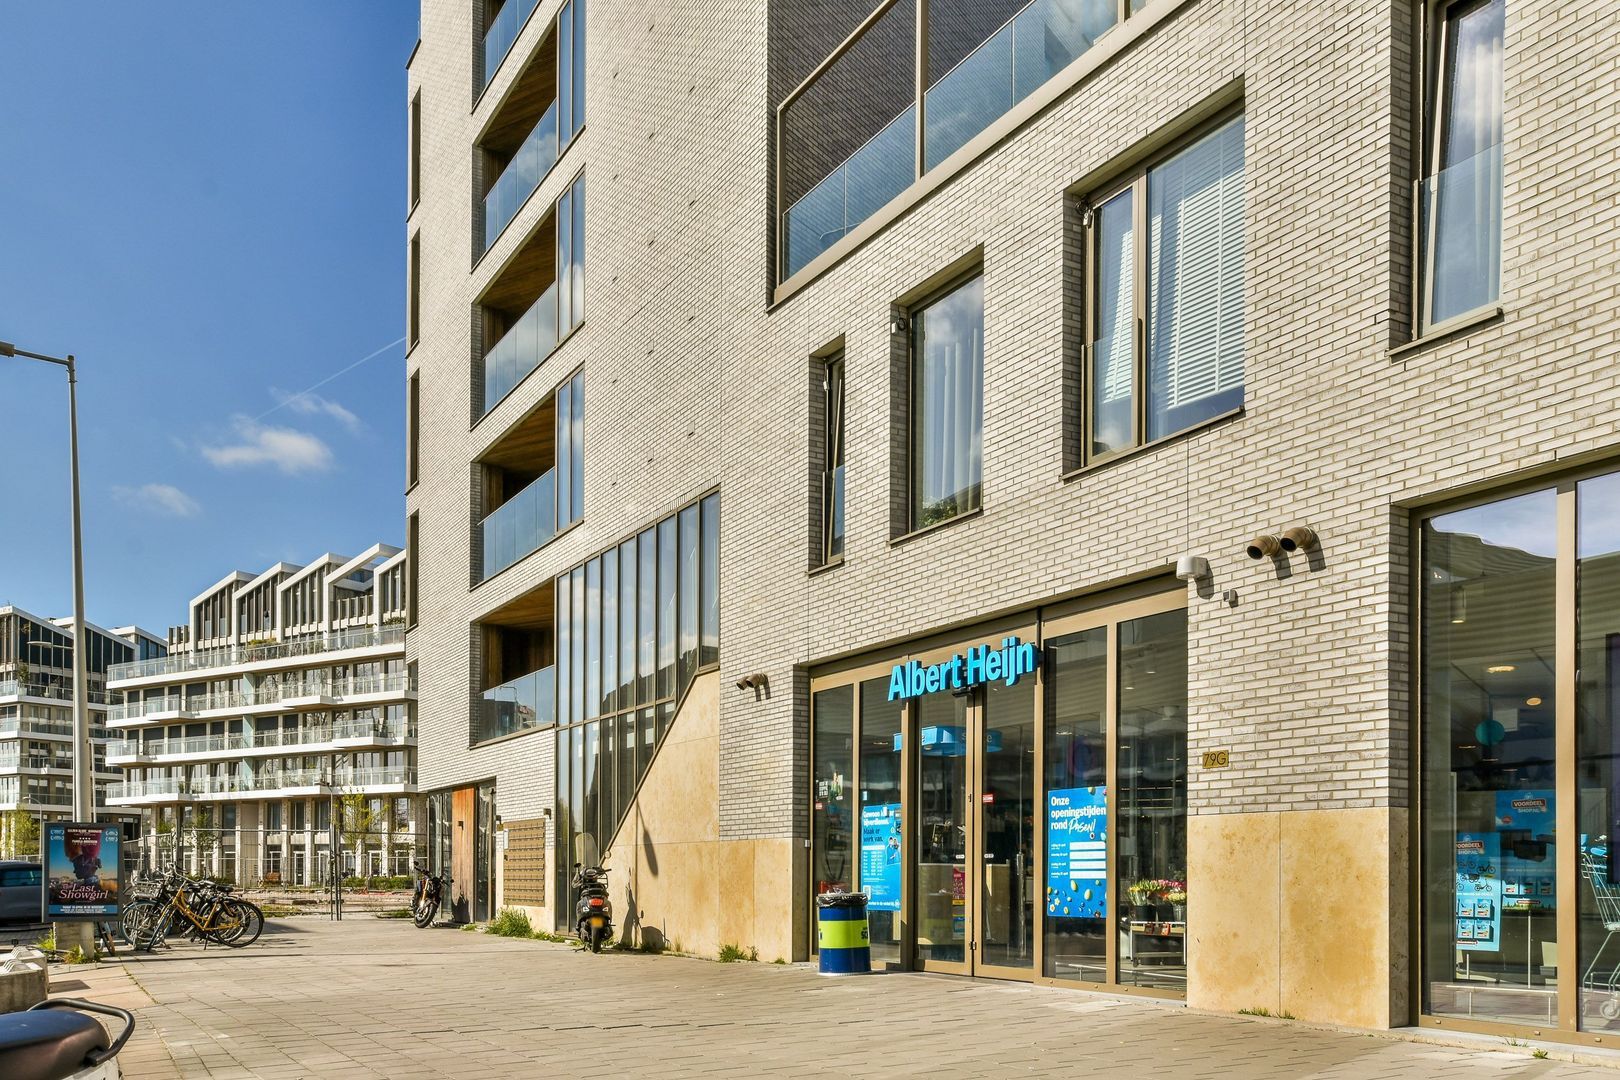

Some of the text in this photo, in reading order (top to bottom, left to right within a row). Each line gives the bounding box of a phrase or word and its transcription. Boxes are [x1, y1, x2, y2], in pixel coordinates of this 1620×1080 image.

[887, 636, 1036, 701] Albert Heijn
[1203, 751, 1227, 767] 79G
[1051, 797, 1070, 806] Onze
[1051, 806, 1106, 820] openingstijden
[1051, 820, 1068, 830] rond
[72, 883, 96, 892] Last
[59, 889, 109, 901] Showgirl
